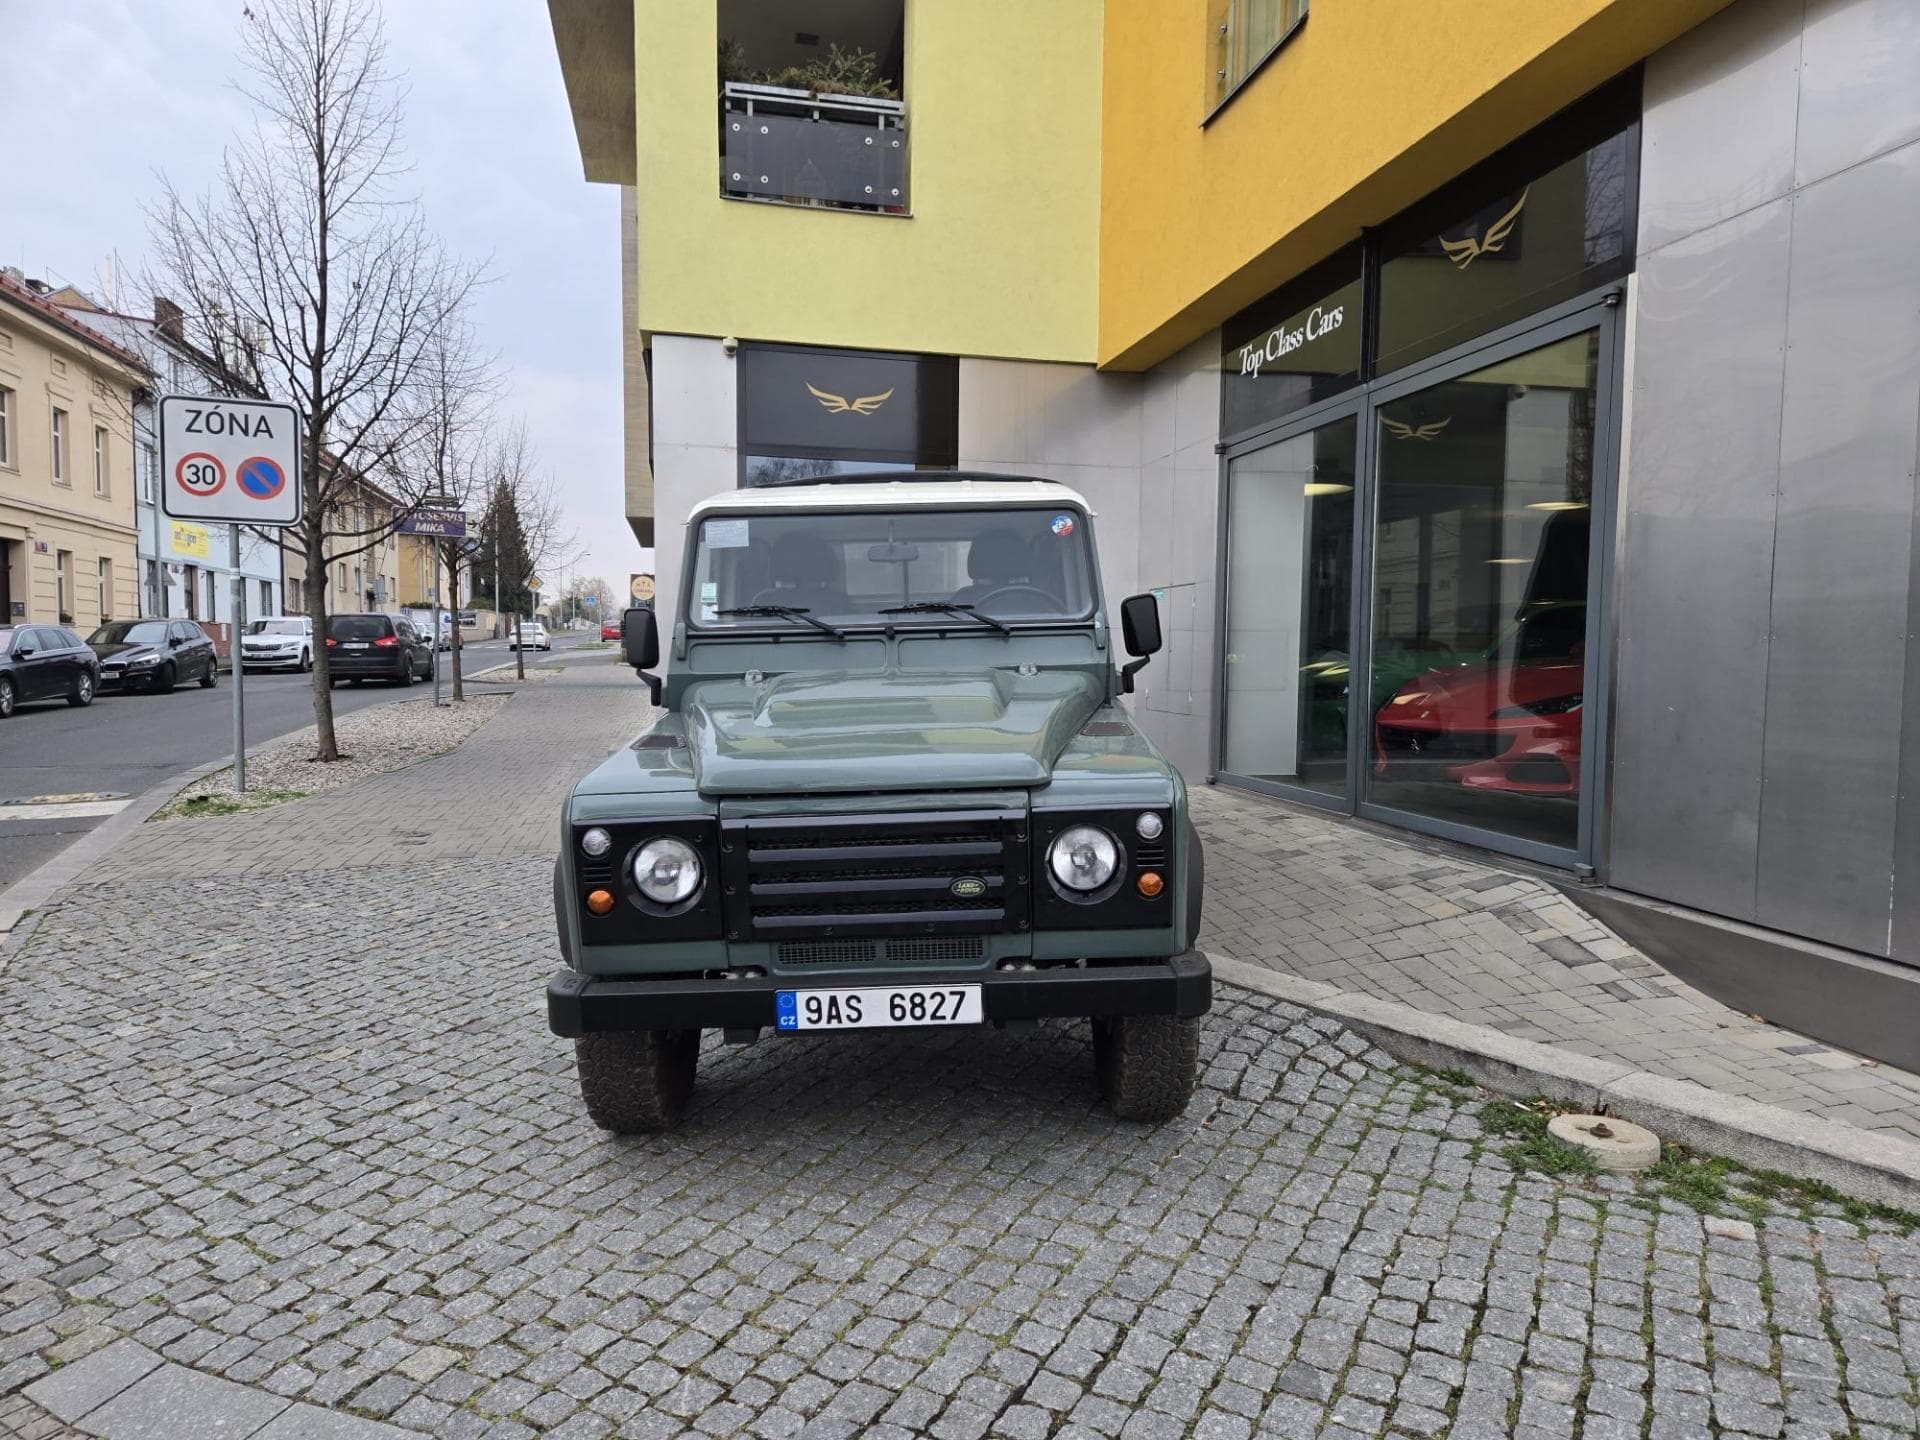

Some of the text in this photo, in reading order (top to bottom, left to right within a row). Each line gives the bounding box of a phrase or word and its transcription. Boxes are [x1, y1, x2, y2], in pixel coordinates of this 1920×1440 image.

[1239, 305, 1344, 379] Top Class Cars
[184, 405, 274, 439] ZÓNA
[186, 463, 216, 485] 30
[394, 508, 464, 522] TOSERVIS
[414, 522, 445, 533] MIKA
[805, 990, 967, 1025] 9AS 6827
[780, 1016, 796, 1026] CZ
